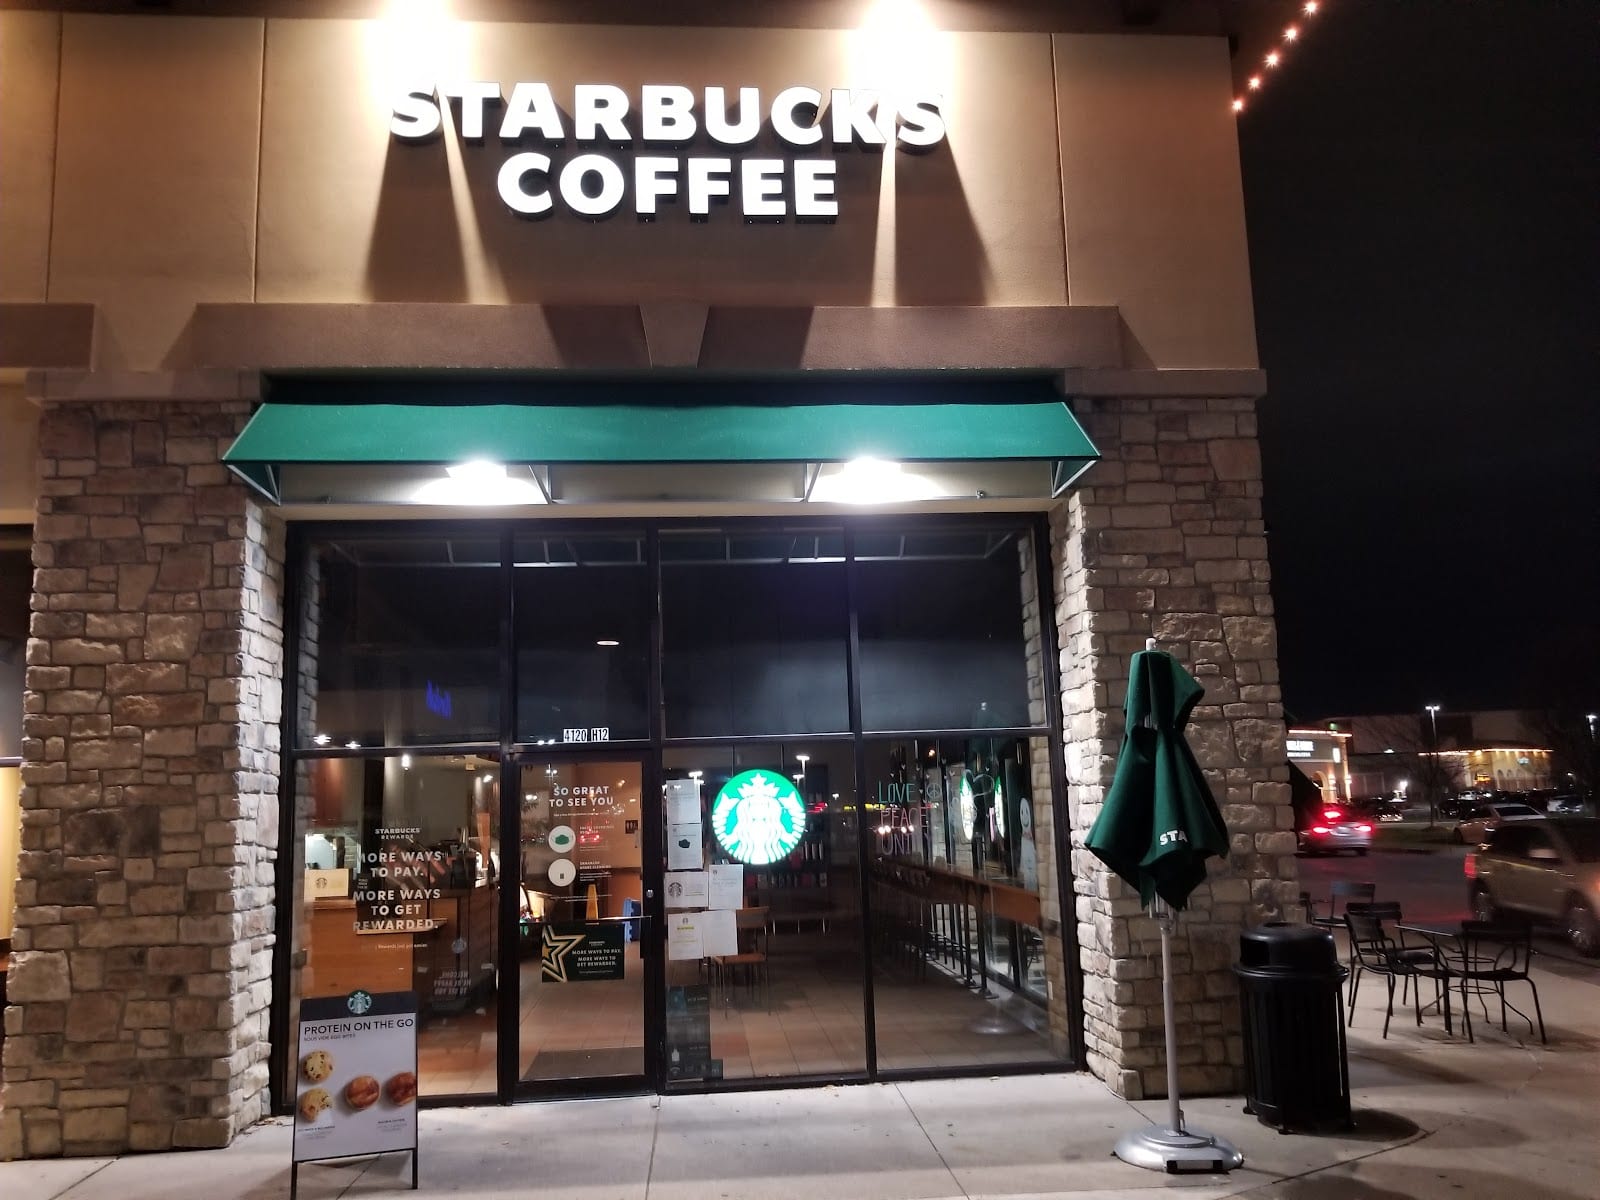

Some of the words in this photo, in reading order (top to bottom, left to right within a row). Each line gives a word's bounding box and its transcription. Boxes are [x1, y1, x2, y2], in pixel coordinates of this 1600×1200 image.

[389, 81, 946, 146] STARBUCKS
[497, 152, 840, 217] COFFEE
[564, 729, 587, 742] 4120
[591, 728, 609, 741] H12
[554, 787, 569, 796] SO
[573, 786, 609, 795] GREAT
[878, 781, 916, 803] LOVE
[549, 799, 564, 807] TO
[568, 798, 587, 807] SEE
[591, 797, 614, 805] YOU
[881, 831, 931, 856] UNIY
[401, 851, 441, 862] WAYS
[371, 868, 388, 877] TO
[394, 867, 424, 877] PAY.
[353, 890, 395, 901] MORE
[400, 889, 440, 900] WAYS
[371, 905, 389, 915] TO
[394, 905, 421, 915] GET
[304, 1024, 350, 1035] PROTEIN
[354, 1022, 371, 1031] ON
[374, 1020, 394, 1030] THE
[397, 1018, 413, 1028] GO
